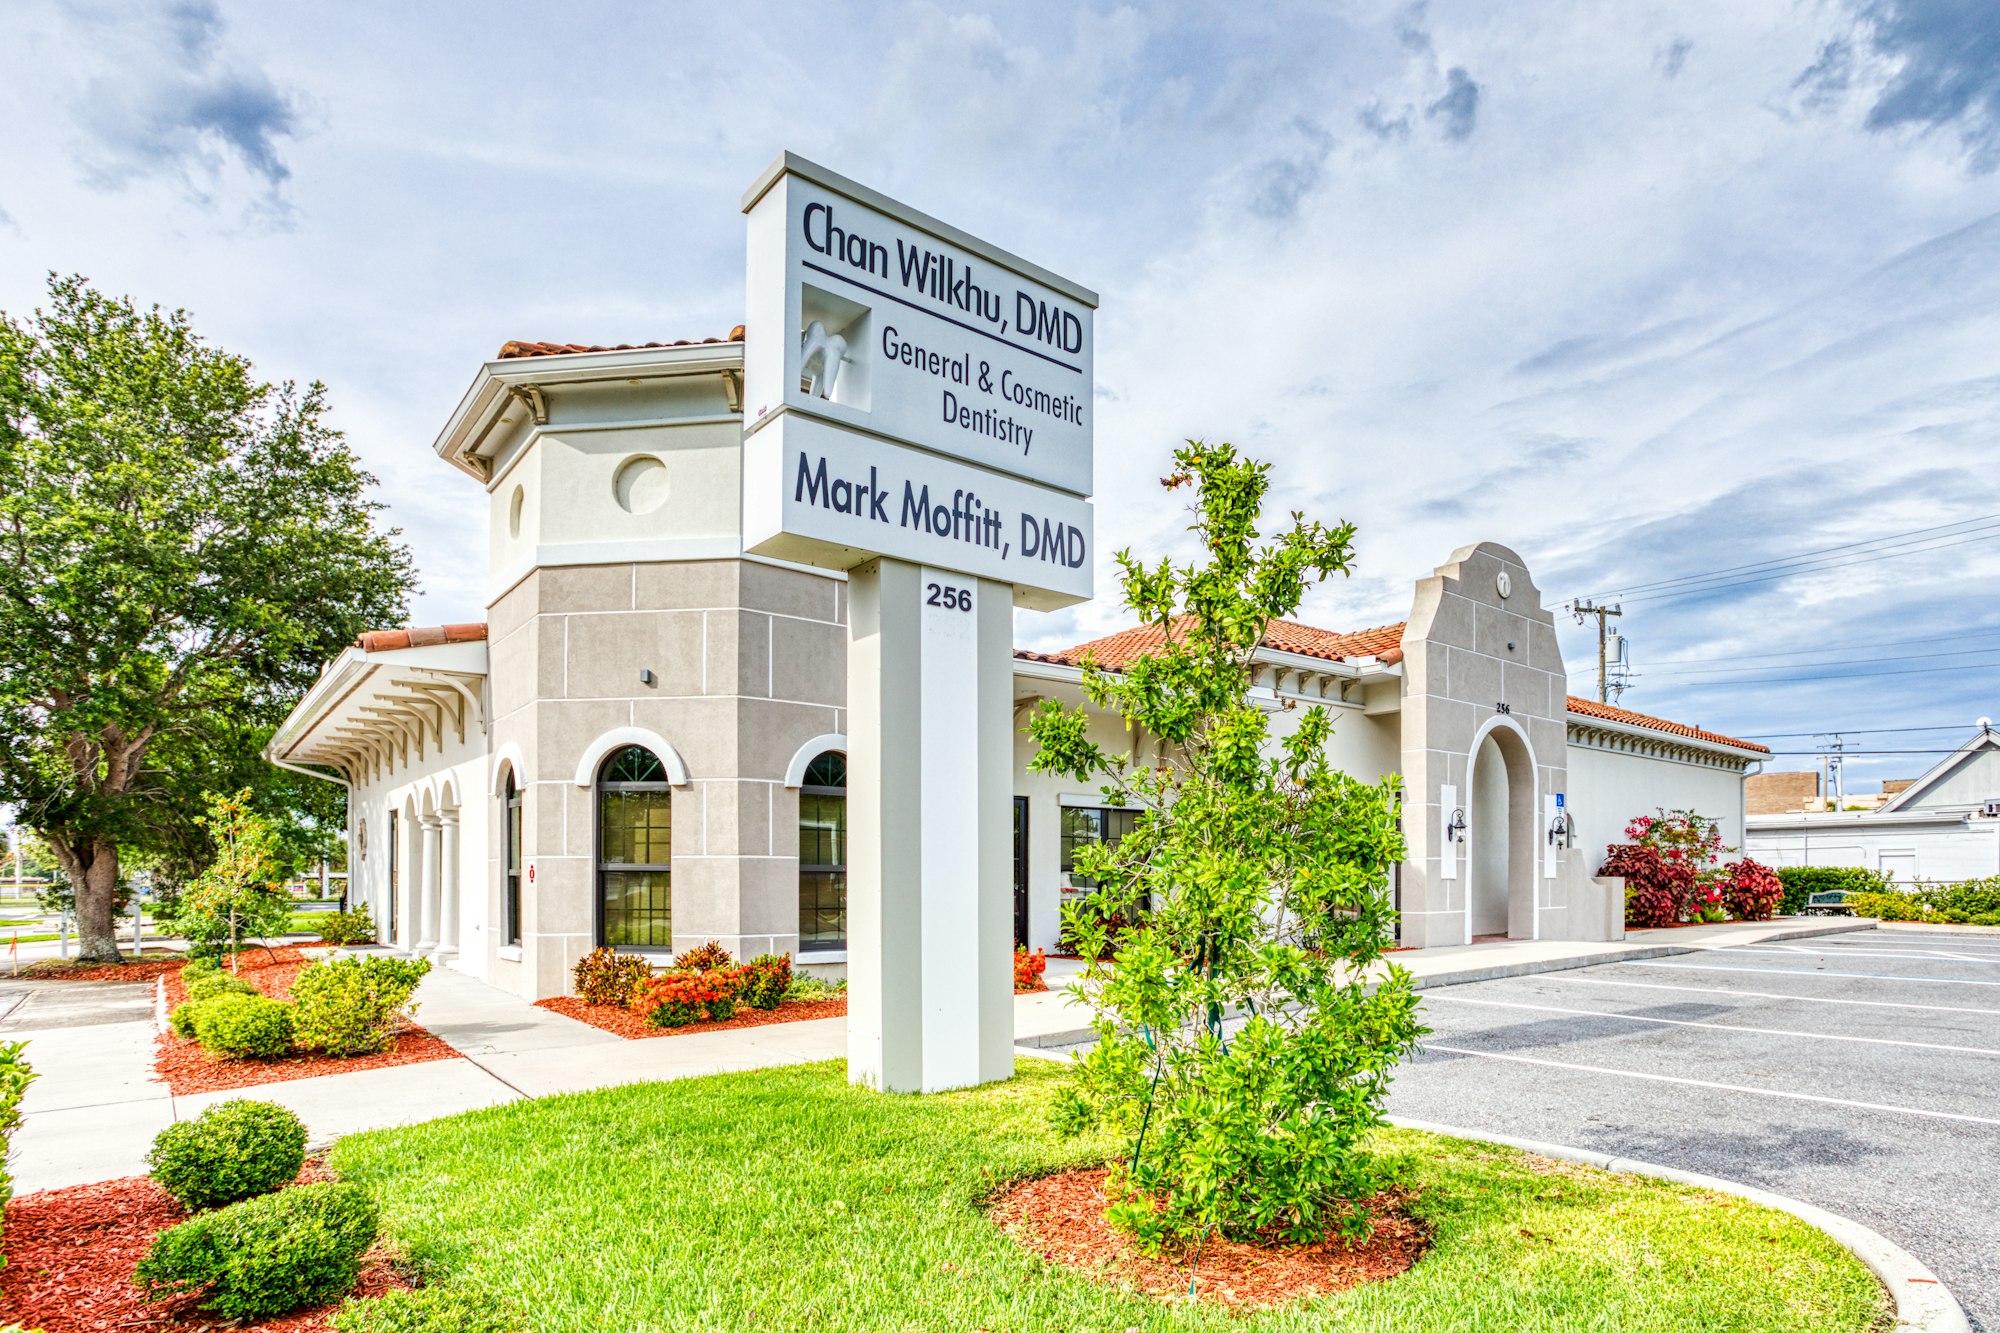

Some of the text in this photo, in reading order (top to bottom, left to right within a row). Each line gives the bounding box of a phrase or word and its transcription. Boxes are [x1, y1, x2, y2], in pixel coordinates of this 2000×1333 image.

[803, 202, 1083, 355] Chan Wilkhu, DMD
[883, 326, 1083, 427] General & Cosmetic
[943, 390, 1033, 456] Dentistry
[795, 451, 1086, 569] Mark Moffitt, DMD
[927, 583, 972, 612] 256
[1496, 702, 1510, 715] 256
